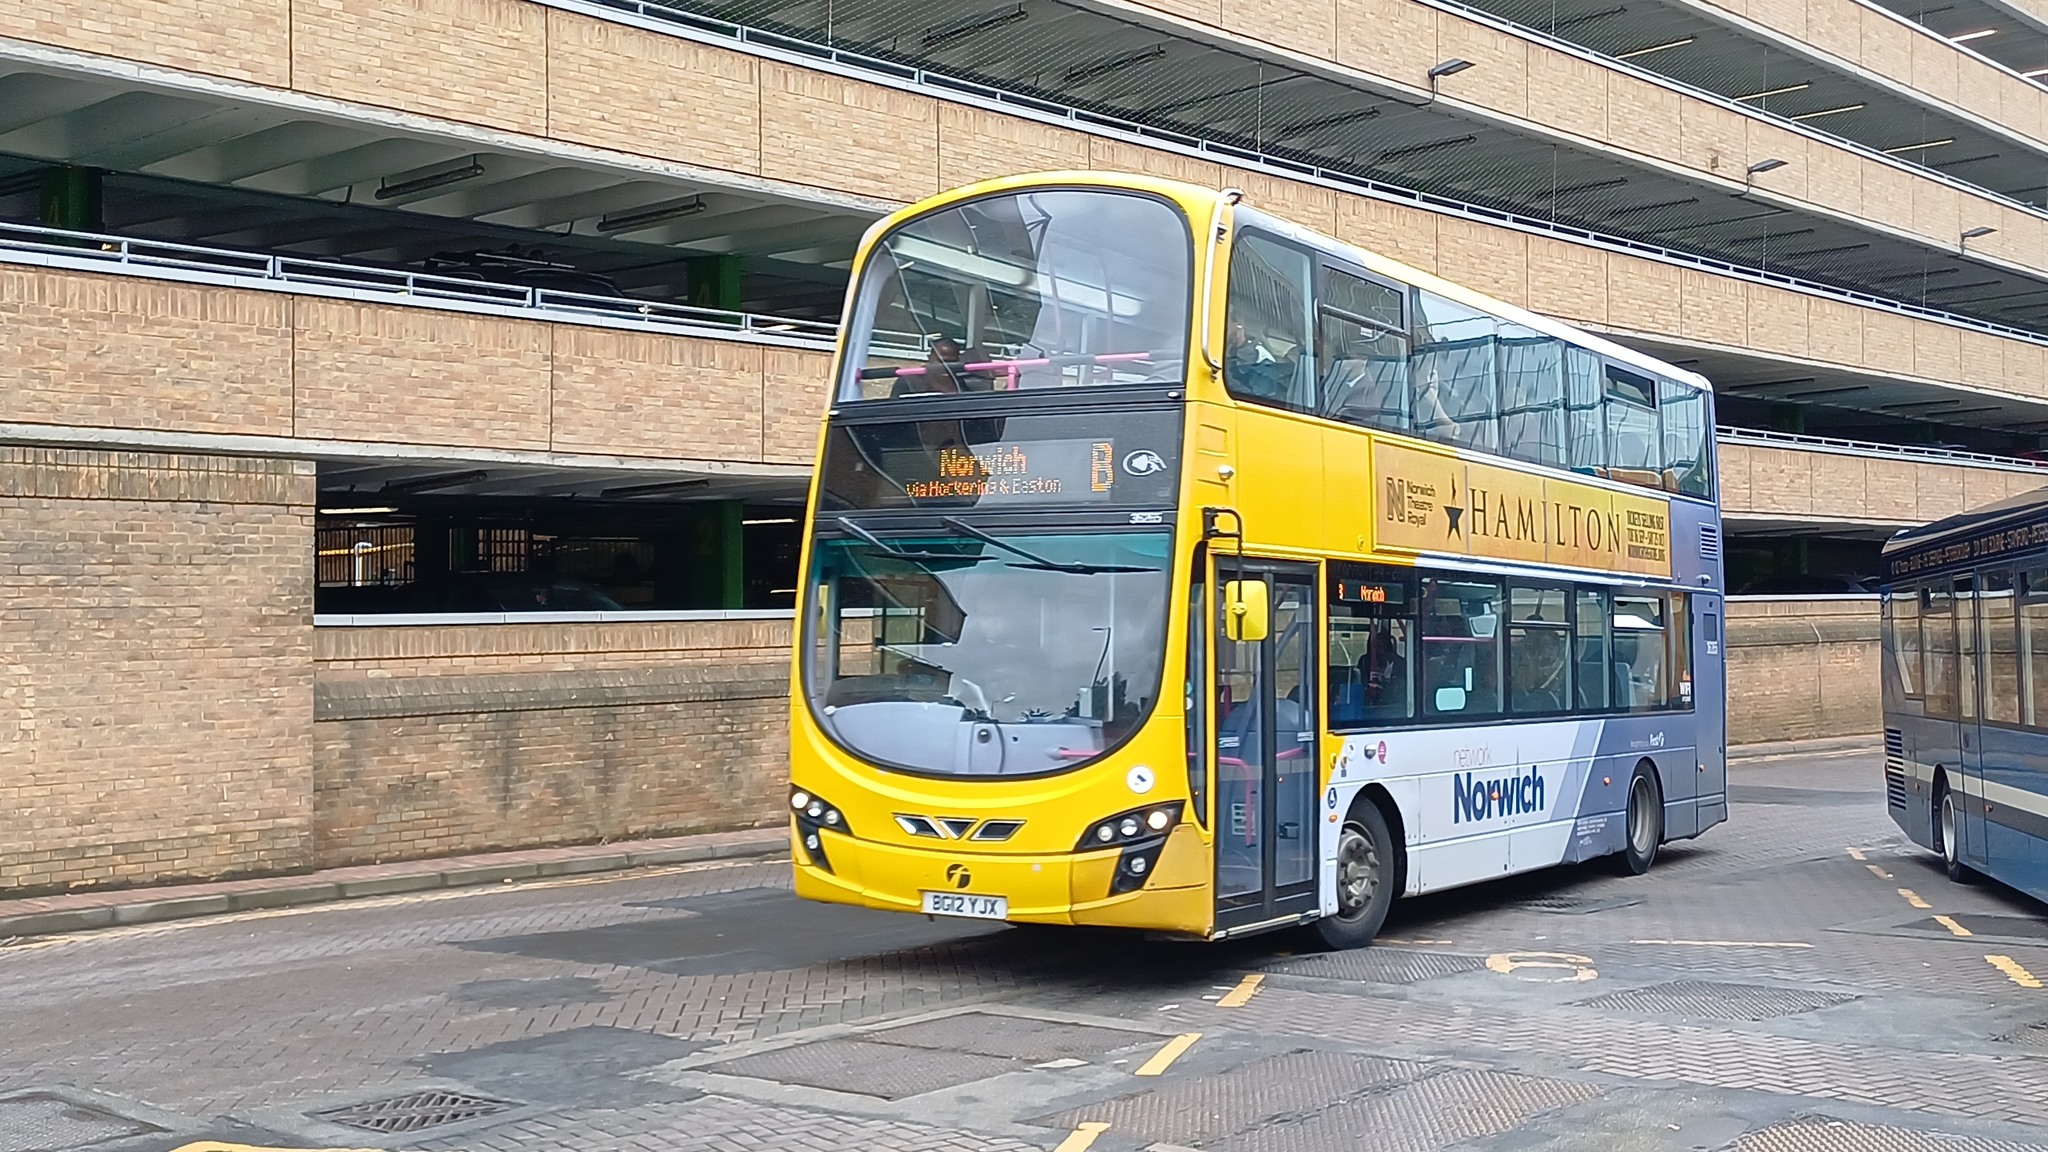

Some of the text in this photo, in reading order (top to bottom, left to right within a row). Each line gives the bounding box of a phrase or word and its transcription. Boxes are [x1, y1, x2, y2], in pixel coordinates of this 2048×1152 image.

[939, 446, 1028, 477] Norwich
[1091, 441, 1115, 492] B
[906, 481, 926, 498] via
[999, 479, 1010, 494] &
[1012, 477, 1062, 494] Easton
[1406, 480, 1436, 497] Norwich
[1406, 496, 1434, 512] Theatre
[1407, 511, 1427, 528] Royal
[1470, 488, 1620, 553] HAMILTON
[1360, 585, 1385, 602] Norwich
[1453, 741, 1493, 768] network
[1454, 765, 1544, 825] Norwich
[932, 894, 998, 915] BG12 YJX
